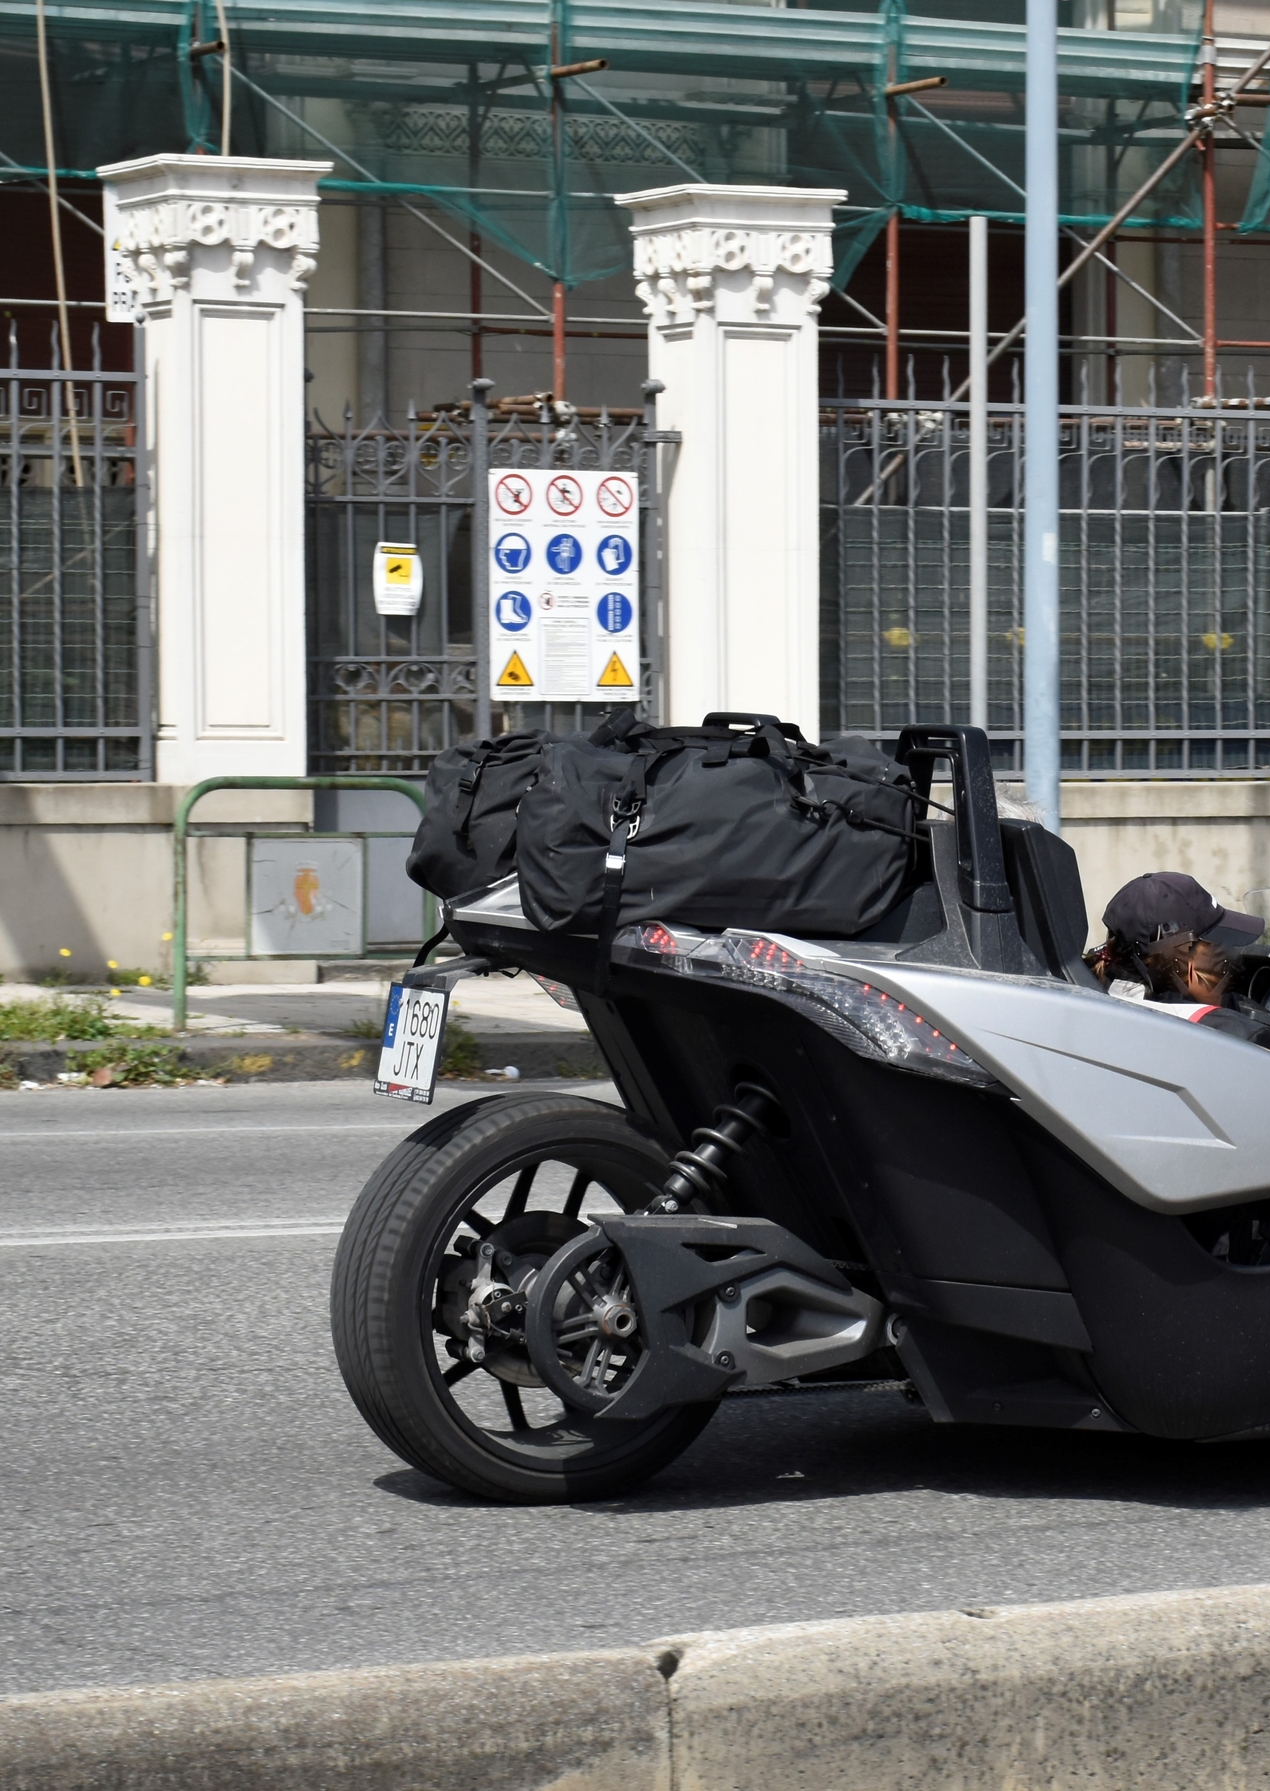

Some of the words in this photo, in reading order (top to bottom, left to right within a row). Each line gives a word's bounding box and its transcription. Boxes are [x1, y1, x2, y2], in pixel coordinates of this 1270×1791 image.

[388, 1023, 395, 1037] E
[401, 998, 440, 1040] 1680
[393, 1040, 425, 1081] JTX
